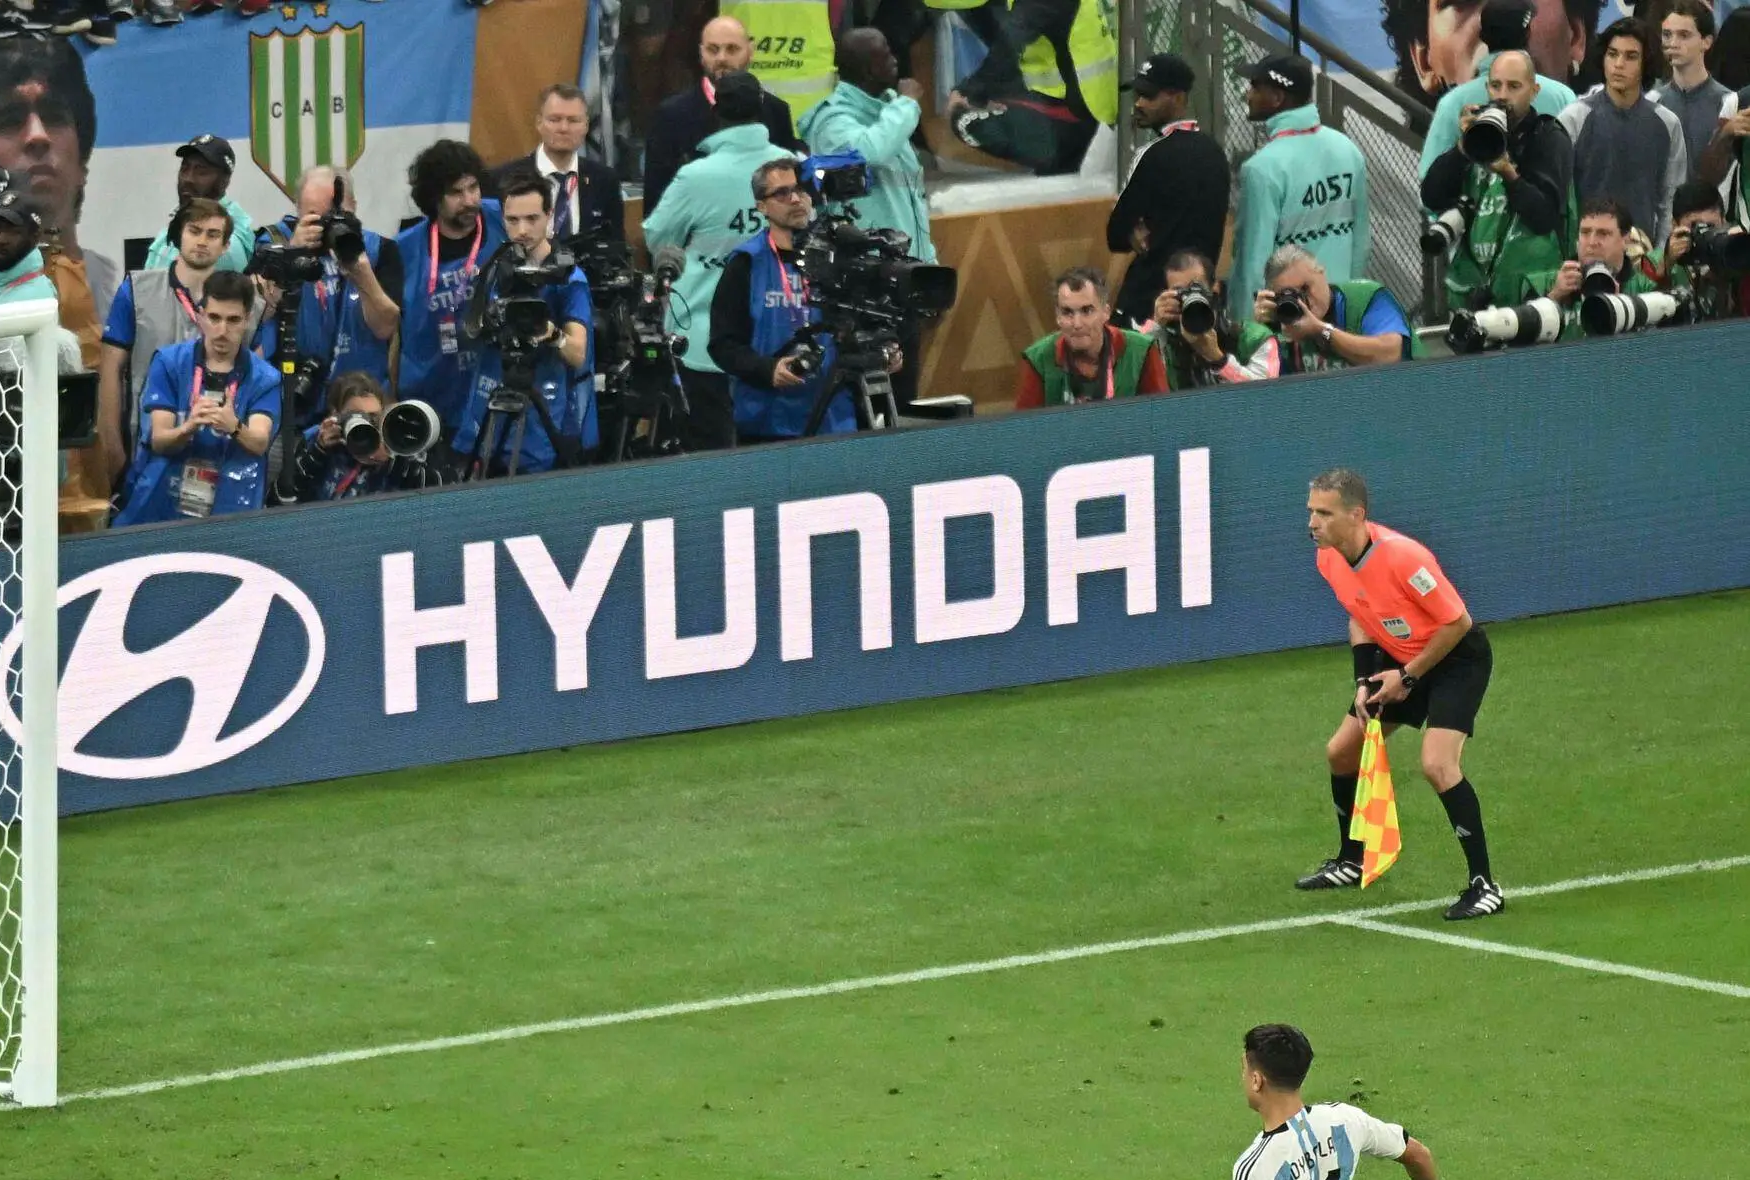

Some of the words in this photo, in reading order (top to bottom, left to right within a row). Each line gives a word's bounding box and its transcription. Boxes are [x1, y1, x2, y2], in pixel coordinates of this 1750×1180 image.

[748, 36, 806, 54] 478
[1302, 173, 1353, 208] 4057
[382, 447, 1212, 714] HYUNDAI
